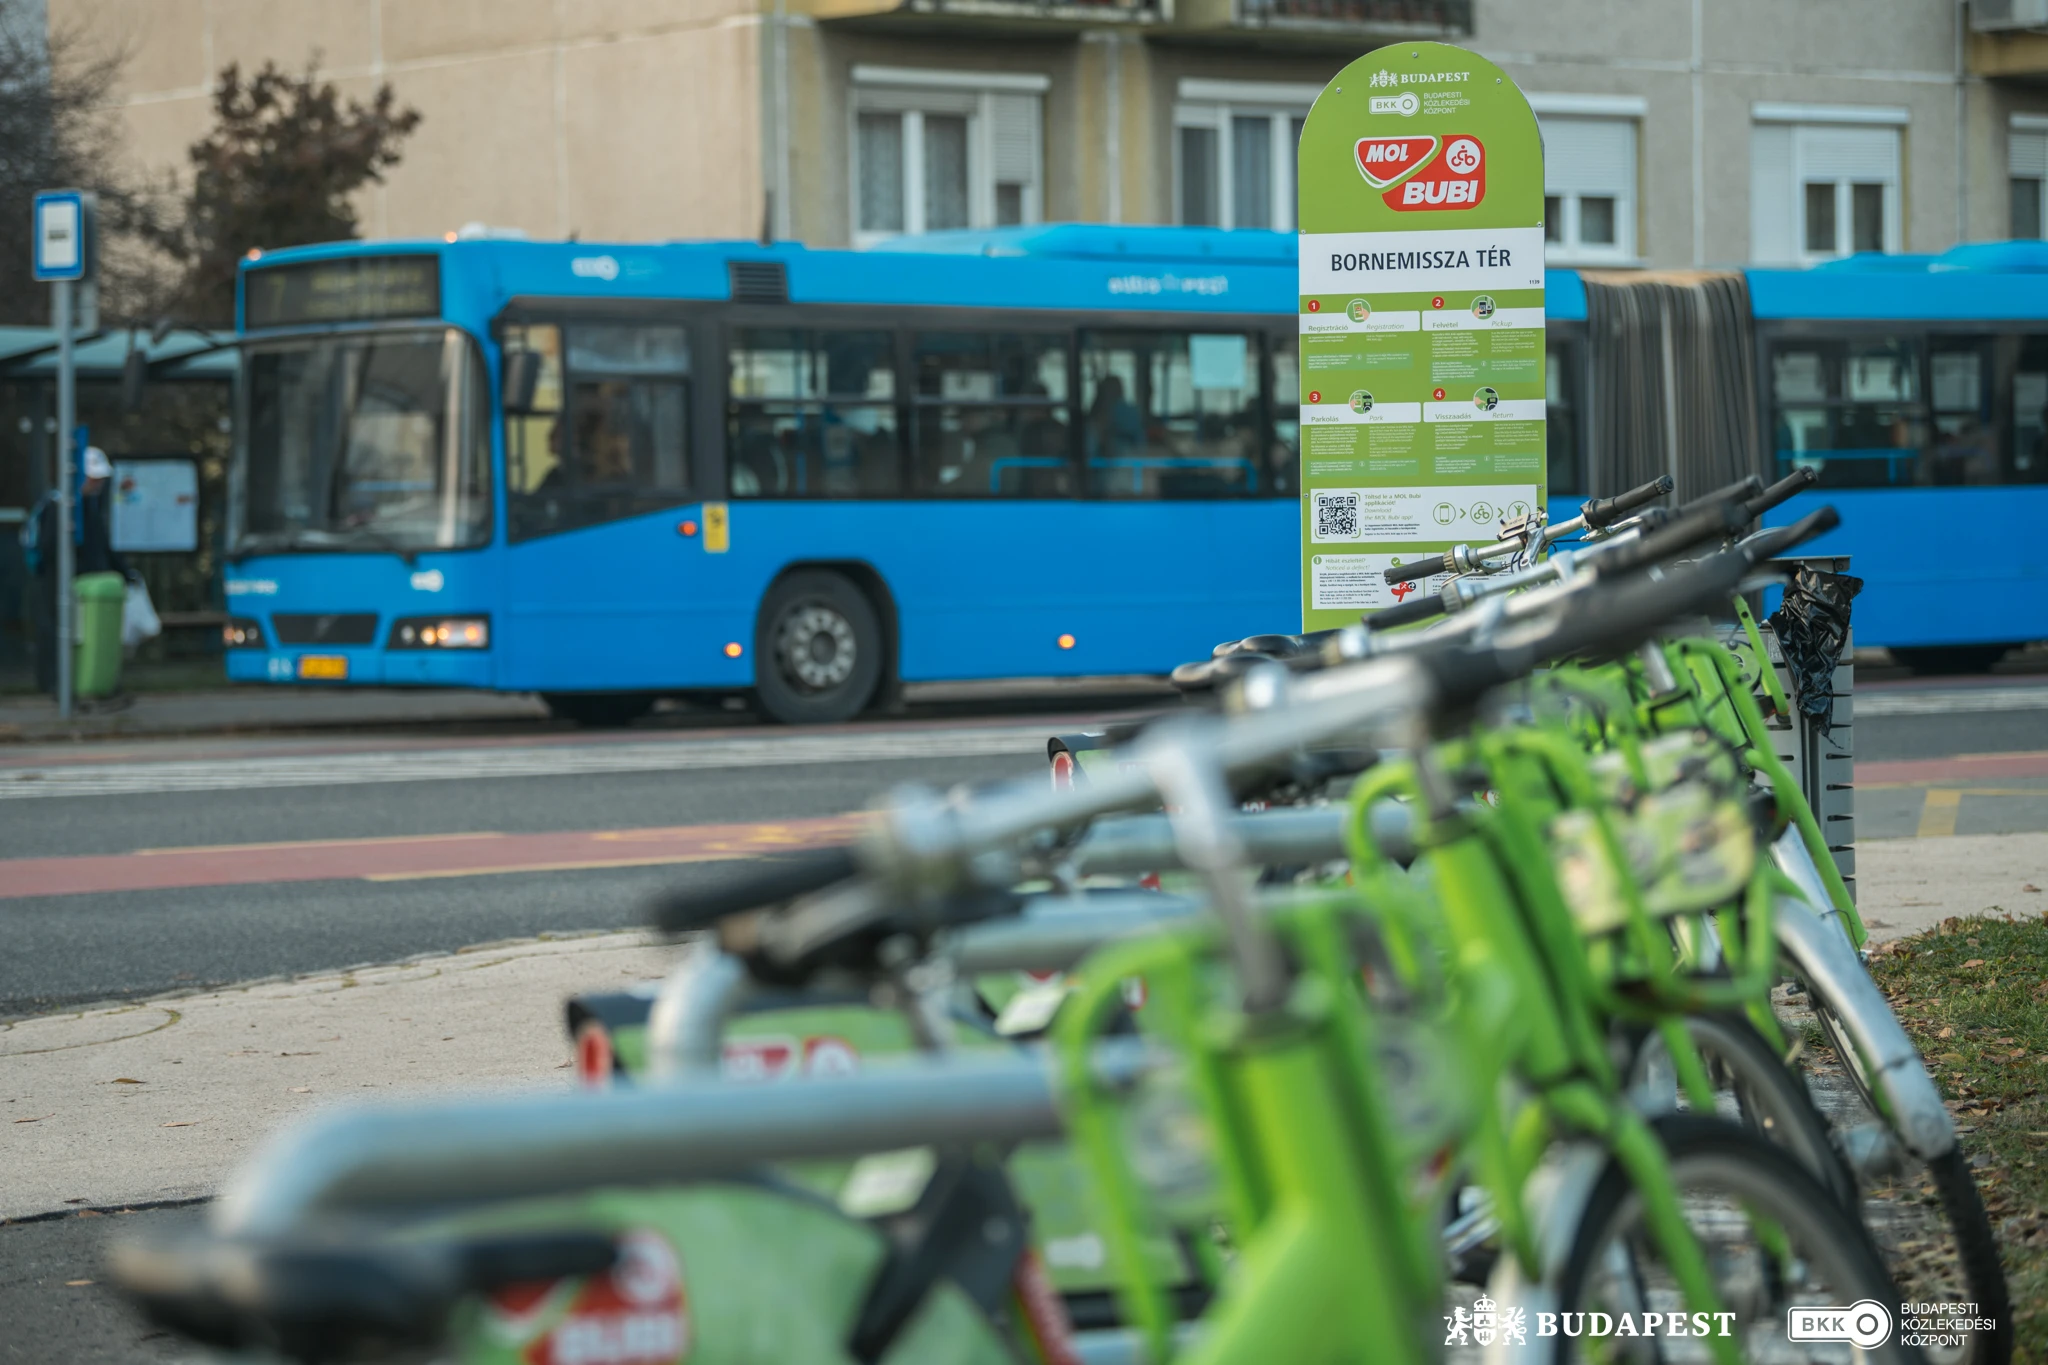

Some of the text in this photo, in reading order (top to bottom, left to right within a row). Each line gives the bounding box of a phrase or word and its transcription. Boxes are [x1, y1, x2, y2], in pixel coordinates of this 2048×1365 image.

[1400, 71, 1470, 84] BUDAPEST
[1376, 101, 1397, 109] BKK
[1423, 98, 1470, 107] KÖZLEKEDÉSI
[1423, 106, 1456, 115] KÖZPONT
[1365, 143, 1409, 163] MOL
[1402, 180, 1478, 205] BUBI
[1331, 245, 1511, 271] BORNEMISSZA TÉR
[1308, 324, 1348, 333] Regisztráció
[1366, 322, 1405, 331] Registration
[1432, 320, 1459, 329] Felvétel
[1491, 319, 1513, 329] Pickup
[1311, 414, 1339, 423] Parkolás
[1369, 413, 1384, 422] Park
[1435, 411, 1472, 420] Visszaadás
[1492, 411, 1514, 419] Return
